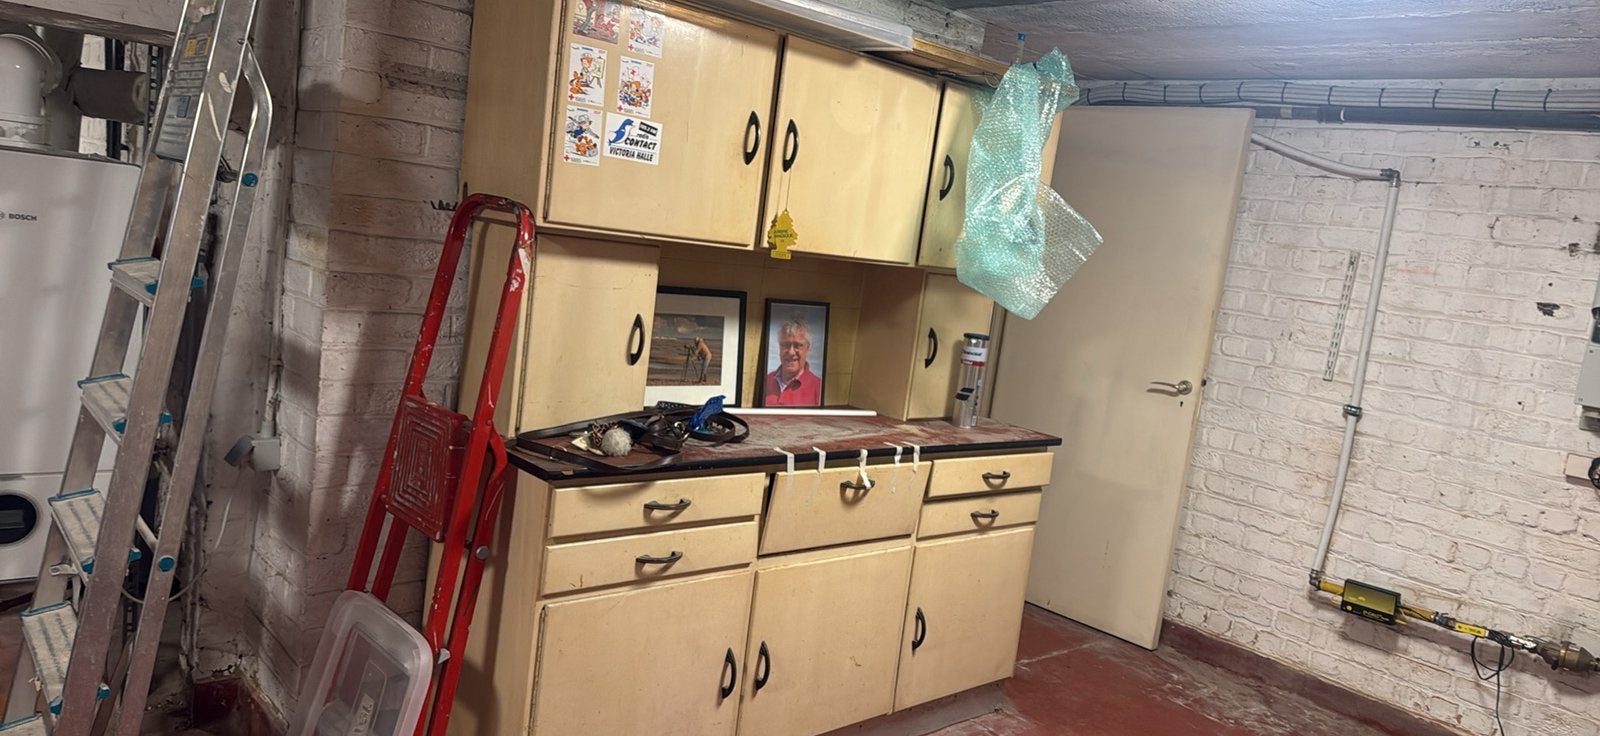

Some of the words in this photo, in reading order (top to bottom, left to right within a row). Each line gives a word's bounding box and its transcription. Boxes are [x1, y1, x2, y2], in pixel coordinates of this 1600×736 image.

[624, 137, 657, 150] CONTACT
[610, 147, 635, 158] VICTORIA
[636, 151, 653, 161] HALLE
[9, 213, 37, 221] BOSCH
